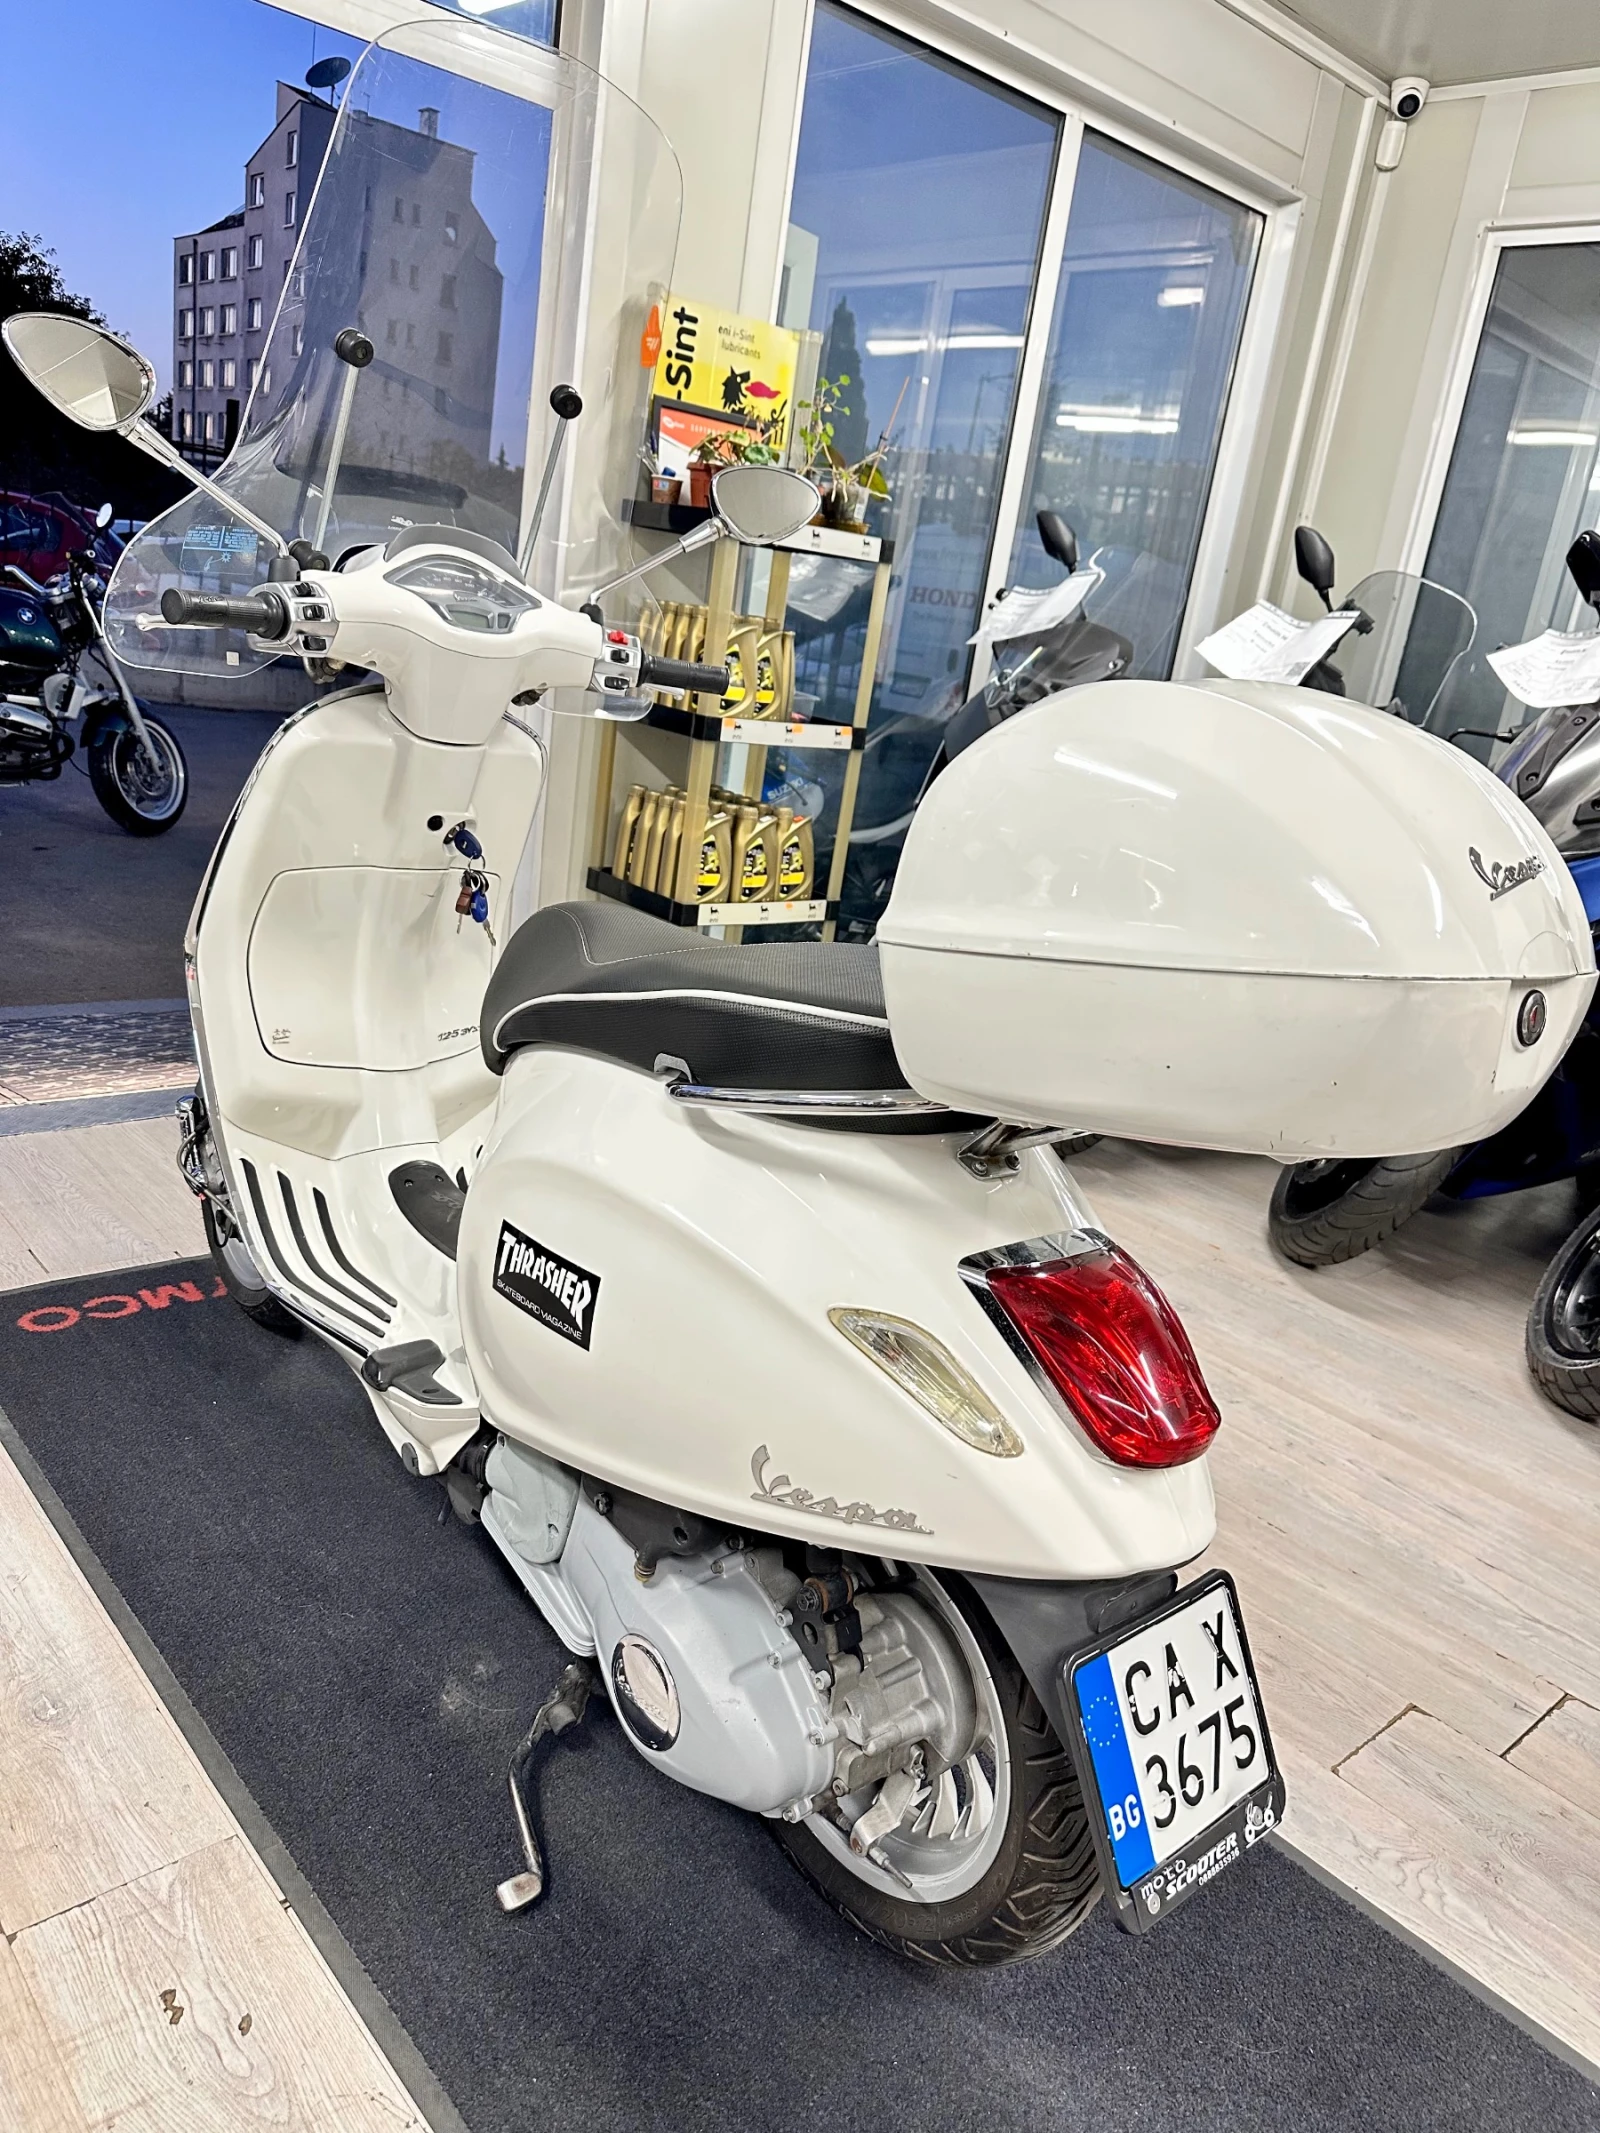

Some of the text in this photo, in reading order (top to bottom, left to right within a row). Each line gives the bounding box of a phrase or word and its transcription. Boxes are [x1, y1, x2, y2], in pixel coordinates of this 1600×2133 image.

[718, 325, 731, 337] eni
[721, 339, 761, 360] lubricants
[496, 1278, 583, 1341] SKATEBOARD MAGAZINE
[498, 1230, 592, 1331] THRASHER
[751, 1444, 935, 1535] Vespa
[1124, 1610, 1239, 1738] CA X
[1145, 1694, 1257, 1830] 3675
[1108, 1793, 1142, 1842] BG
[1140, 1859, 1187, 1900] moto
[1165, 1831, 1238, 1901] SCOOTER
